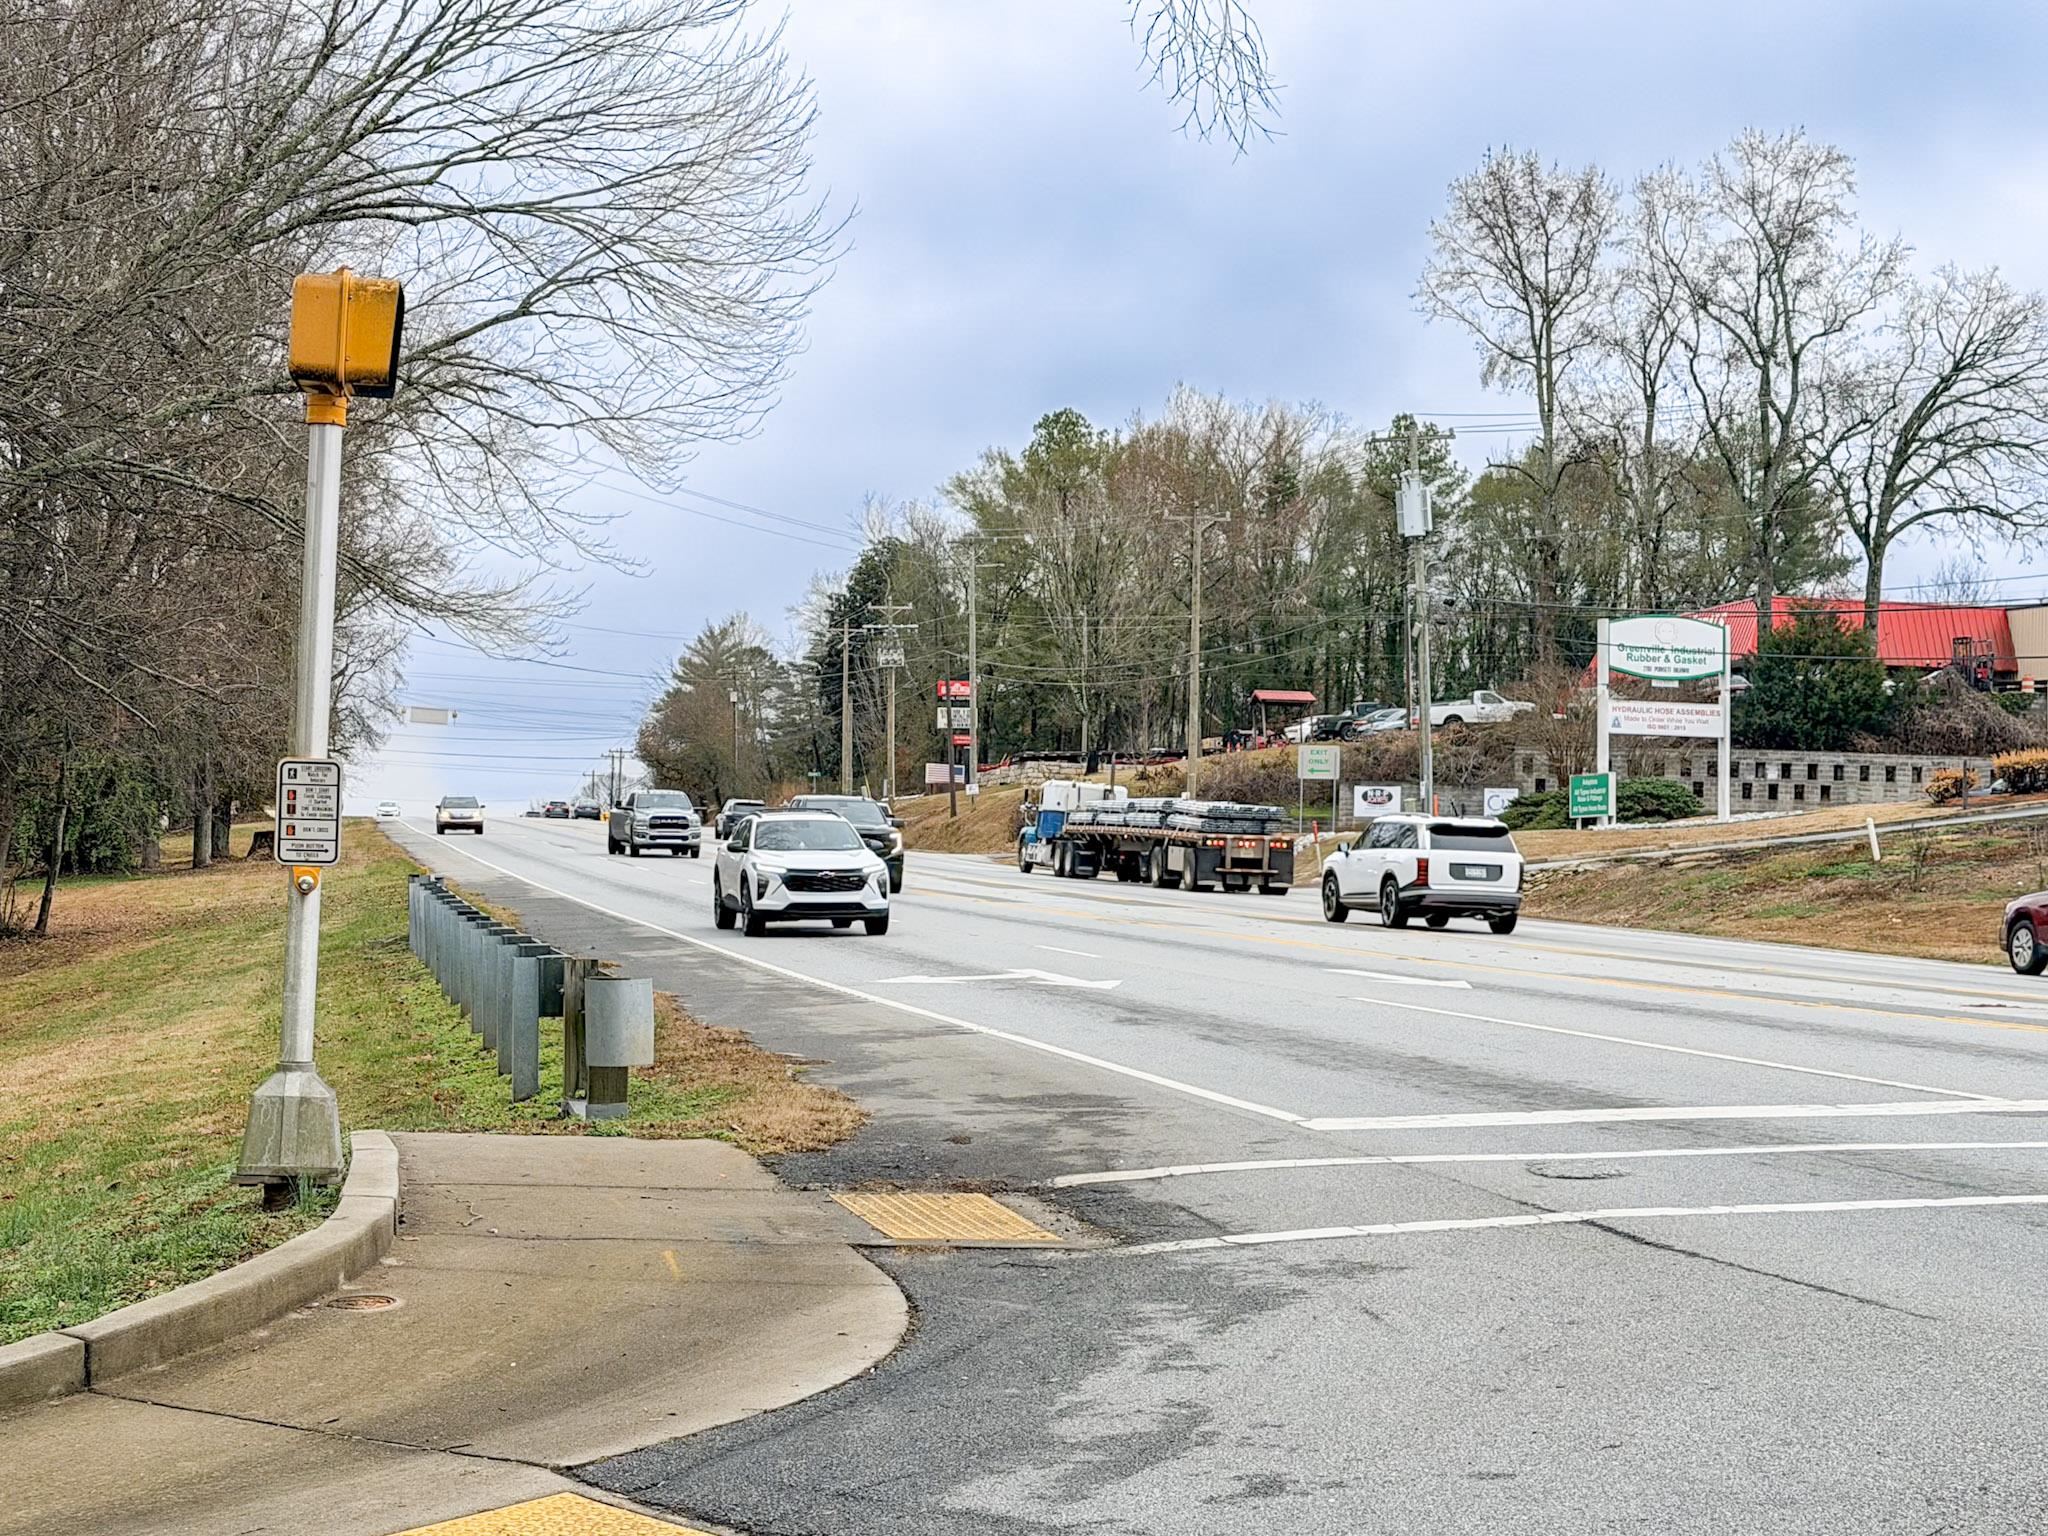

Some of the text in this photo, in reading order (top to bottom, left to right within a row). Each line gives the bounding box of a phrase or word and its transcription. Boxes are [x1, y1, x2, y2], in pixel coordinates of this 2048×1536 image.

[1617, 643, 1716, 656] Greenville Industrial
[1626, 653, 1707, 665] Rubber & Gasket
[1612, 706, 1721, 717] HYDRAULIC HOSE ASSEMBLIES
